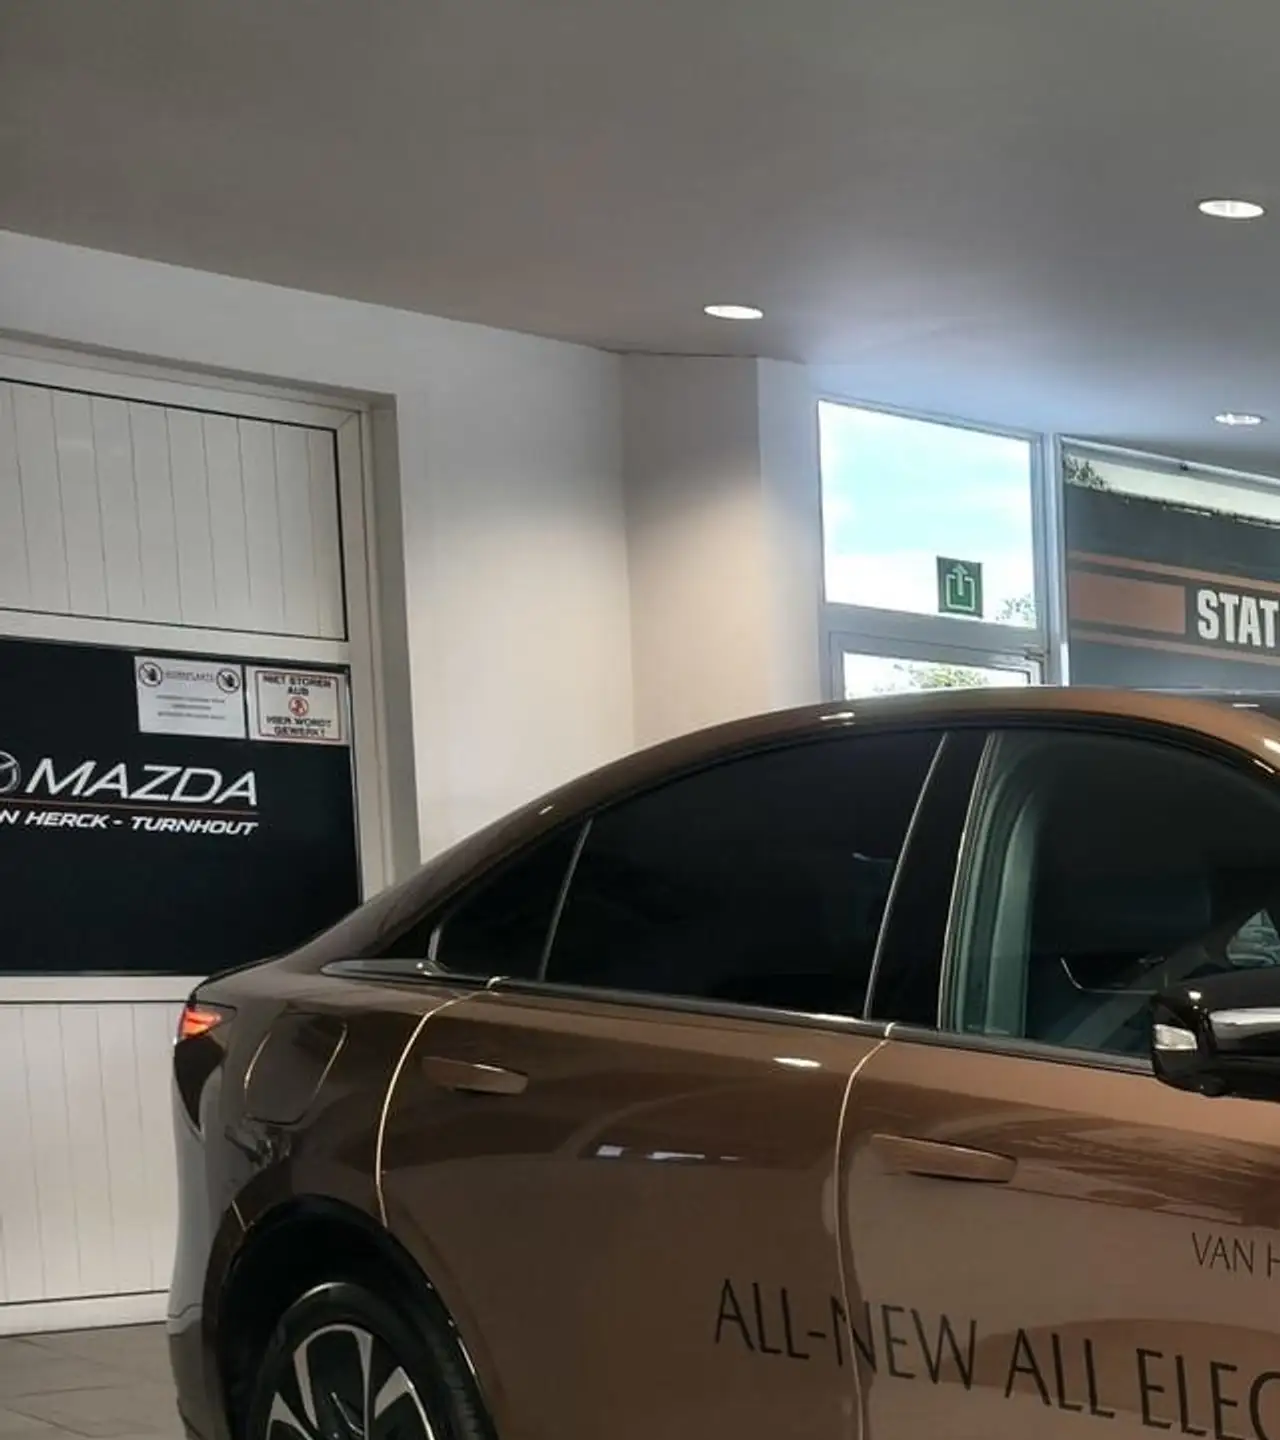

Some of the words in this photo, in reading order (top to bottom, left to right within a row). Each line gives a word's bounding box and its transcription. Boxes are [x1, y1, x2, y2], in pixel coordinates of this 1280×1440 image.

[25, 758, 257, 806] MAZDA
[24, 810, 110, 829] HERCK
[130, 815, 259, 836] TURNHOUT
[1191, 1231, 1255, 1275] VAN
[714, 1277, 977, 1391] ALL-NEW
[1004, 1328, 1116, 1418] ALL
